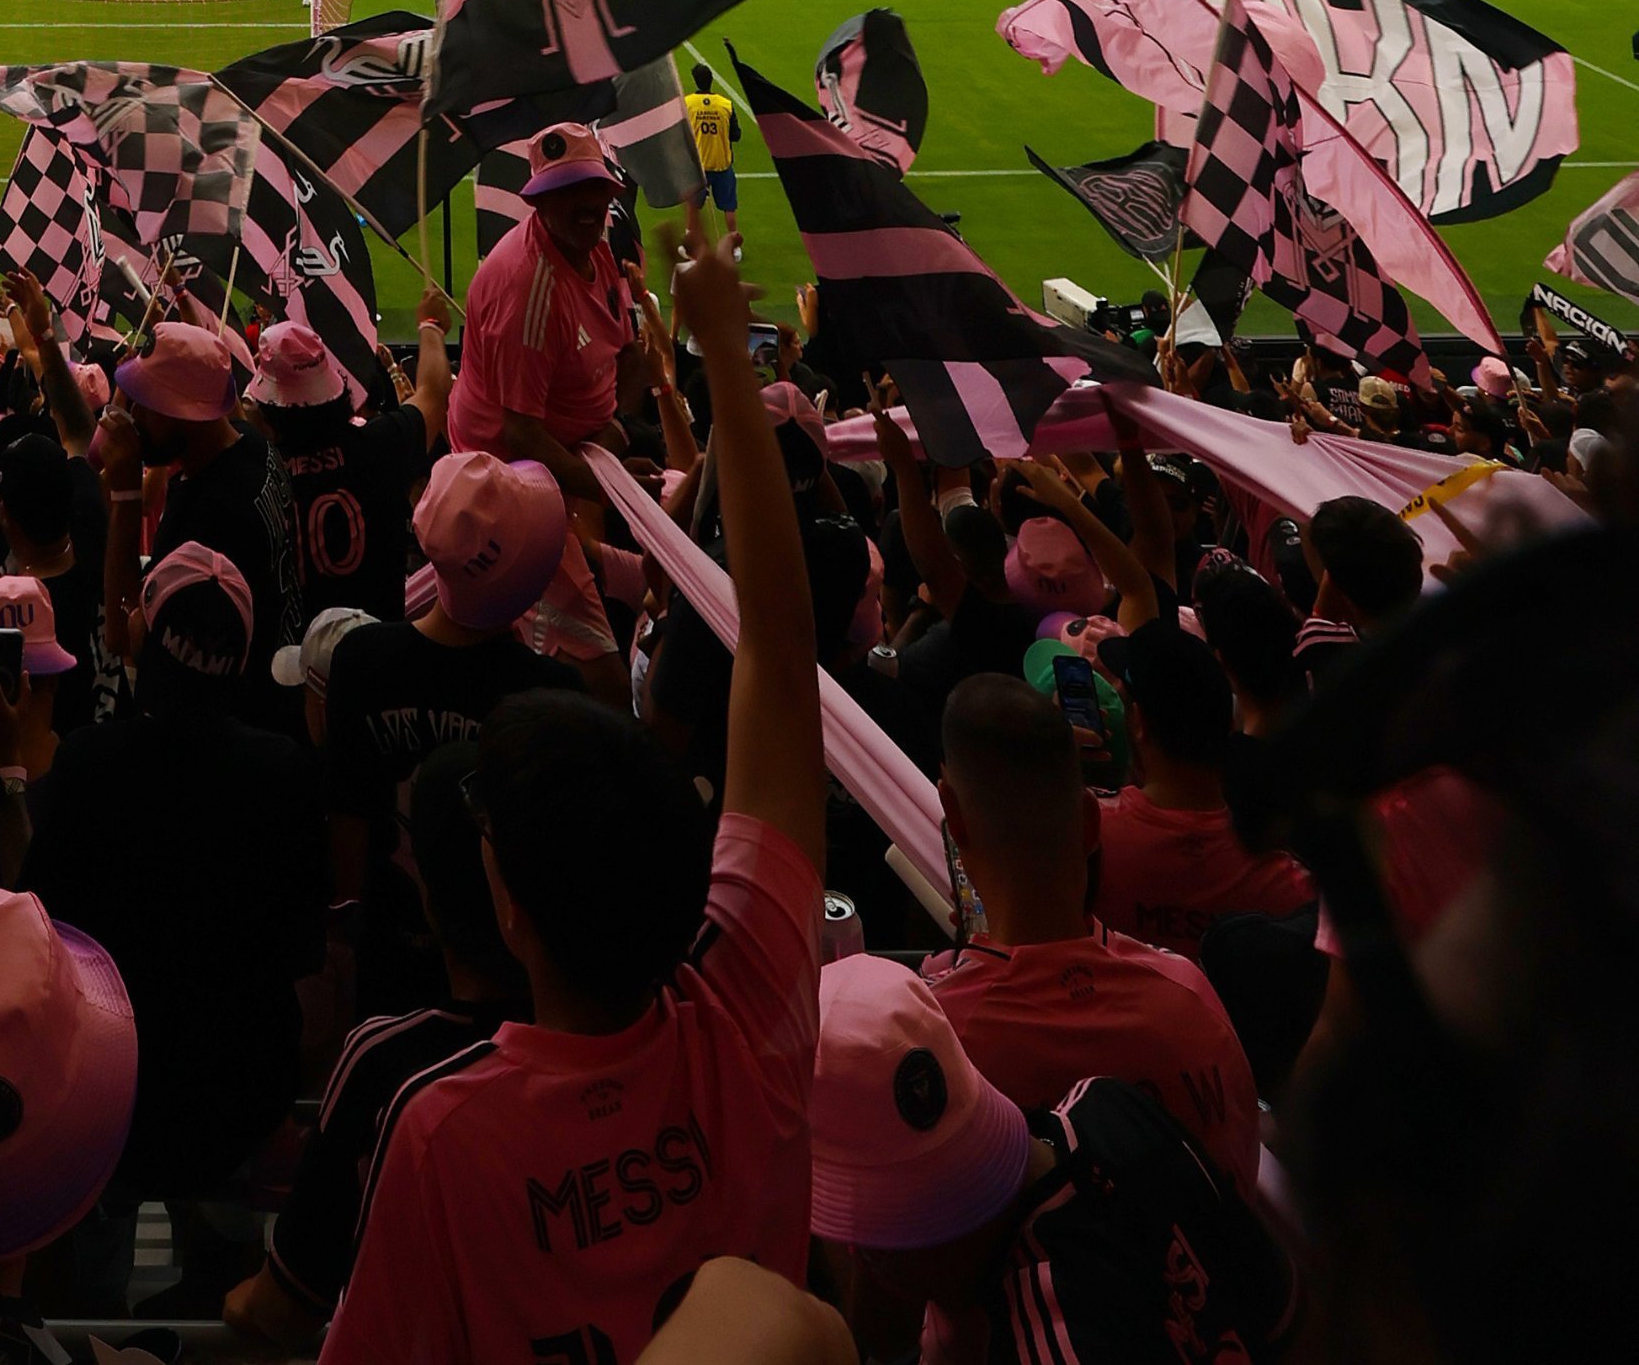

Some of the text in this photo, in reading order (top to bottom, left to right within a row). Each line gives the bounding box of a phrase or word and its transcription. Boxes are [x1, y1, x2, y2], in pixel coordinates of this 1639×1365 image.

[700, 121, 718, 135] 03
[283, 446, 346, 477] MESSI
[161, 625, 237, 679] MIAMI
[1134, 899, 1206, 943] MES
[525, 1108, 715, 1256] MESSI
